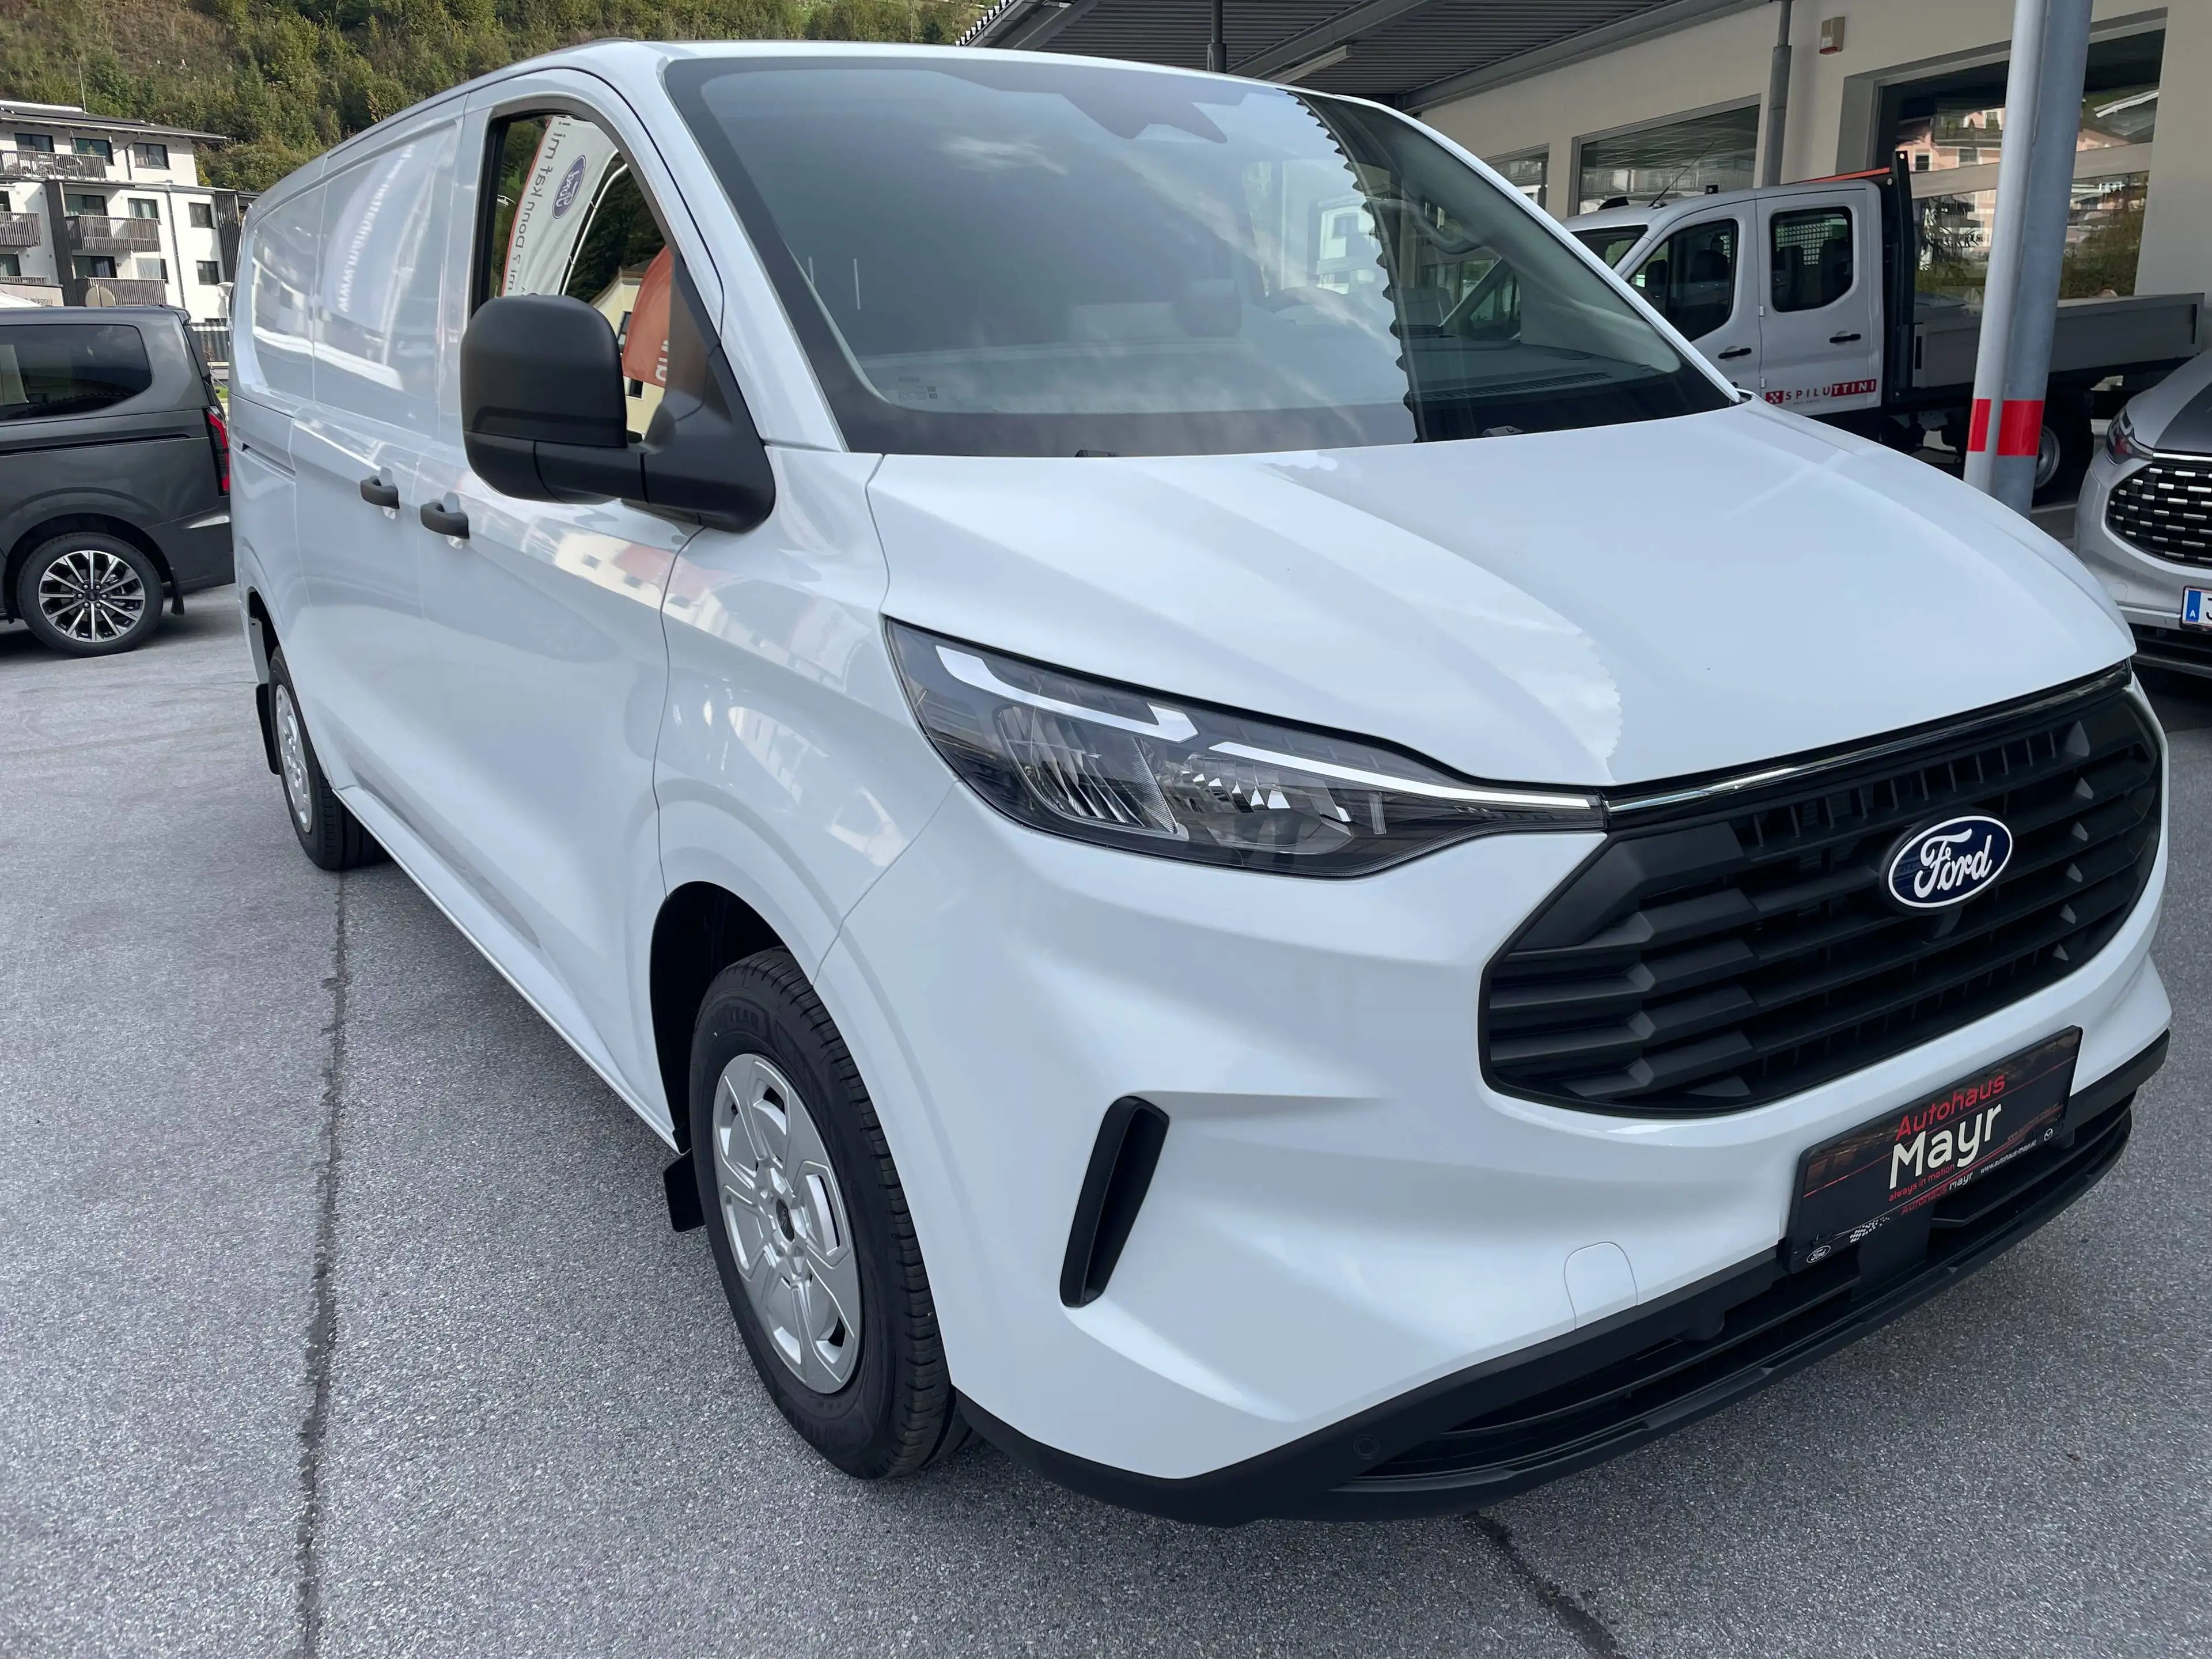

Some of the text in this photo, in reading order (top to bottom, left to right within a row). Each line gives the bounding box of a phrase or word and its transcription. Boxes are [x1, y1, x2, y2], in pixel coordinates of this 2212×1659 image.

[1785, 380, 1876, 401] SPILUTTINI
[2190, 609, 2196, 618] A
[1913, 828, 1993, 899] Ford
[1895, 1074, 2005, 1141] Autohaus
[1889, 1103, 2002, 1190] Mayr
[1888, 1164, 1955, 1202] always in motion
[1949, 1172, 1974, 1191] Mayr
